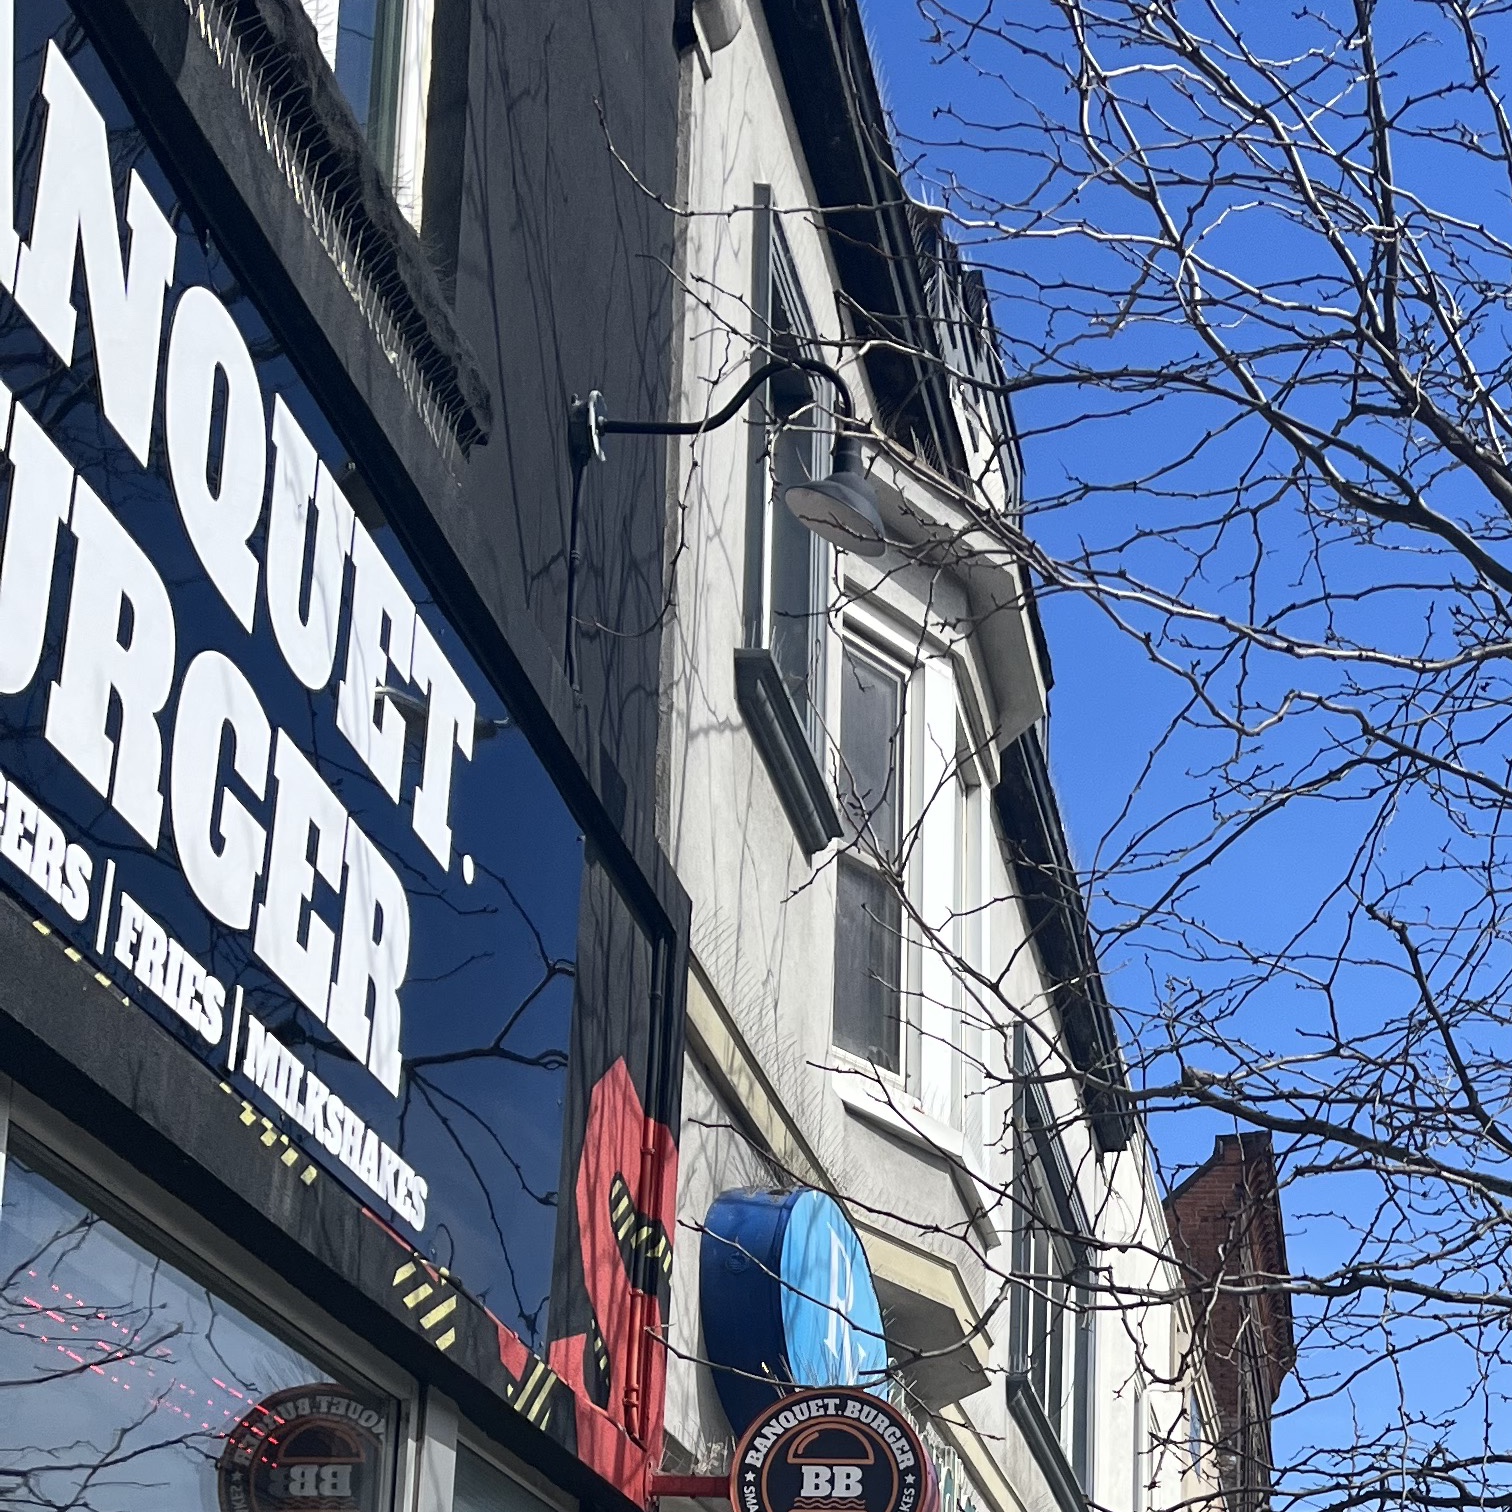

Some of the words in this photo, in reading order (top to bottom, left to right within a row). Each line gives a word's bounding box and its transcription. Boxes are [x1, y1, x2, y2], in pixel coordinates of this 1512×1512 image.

[0, 20, 475, 885] NQUET.
[0, 771, 93, 921] ERS
[113, 891, 226, 1044] FRIES
[242, 1014, 428, 1232] MILKSHAKES
[800, 1465, 863, 1498] BB
[843, 1399, 915, 1471] BURGER
